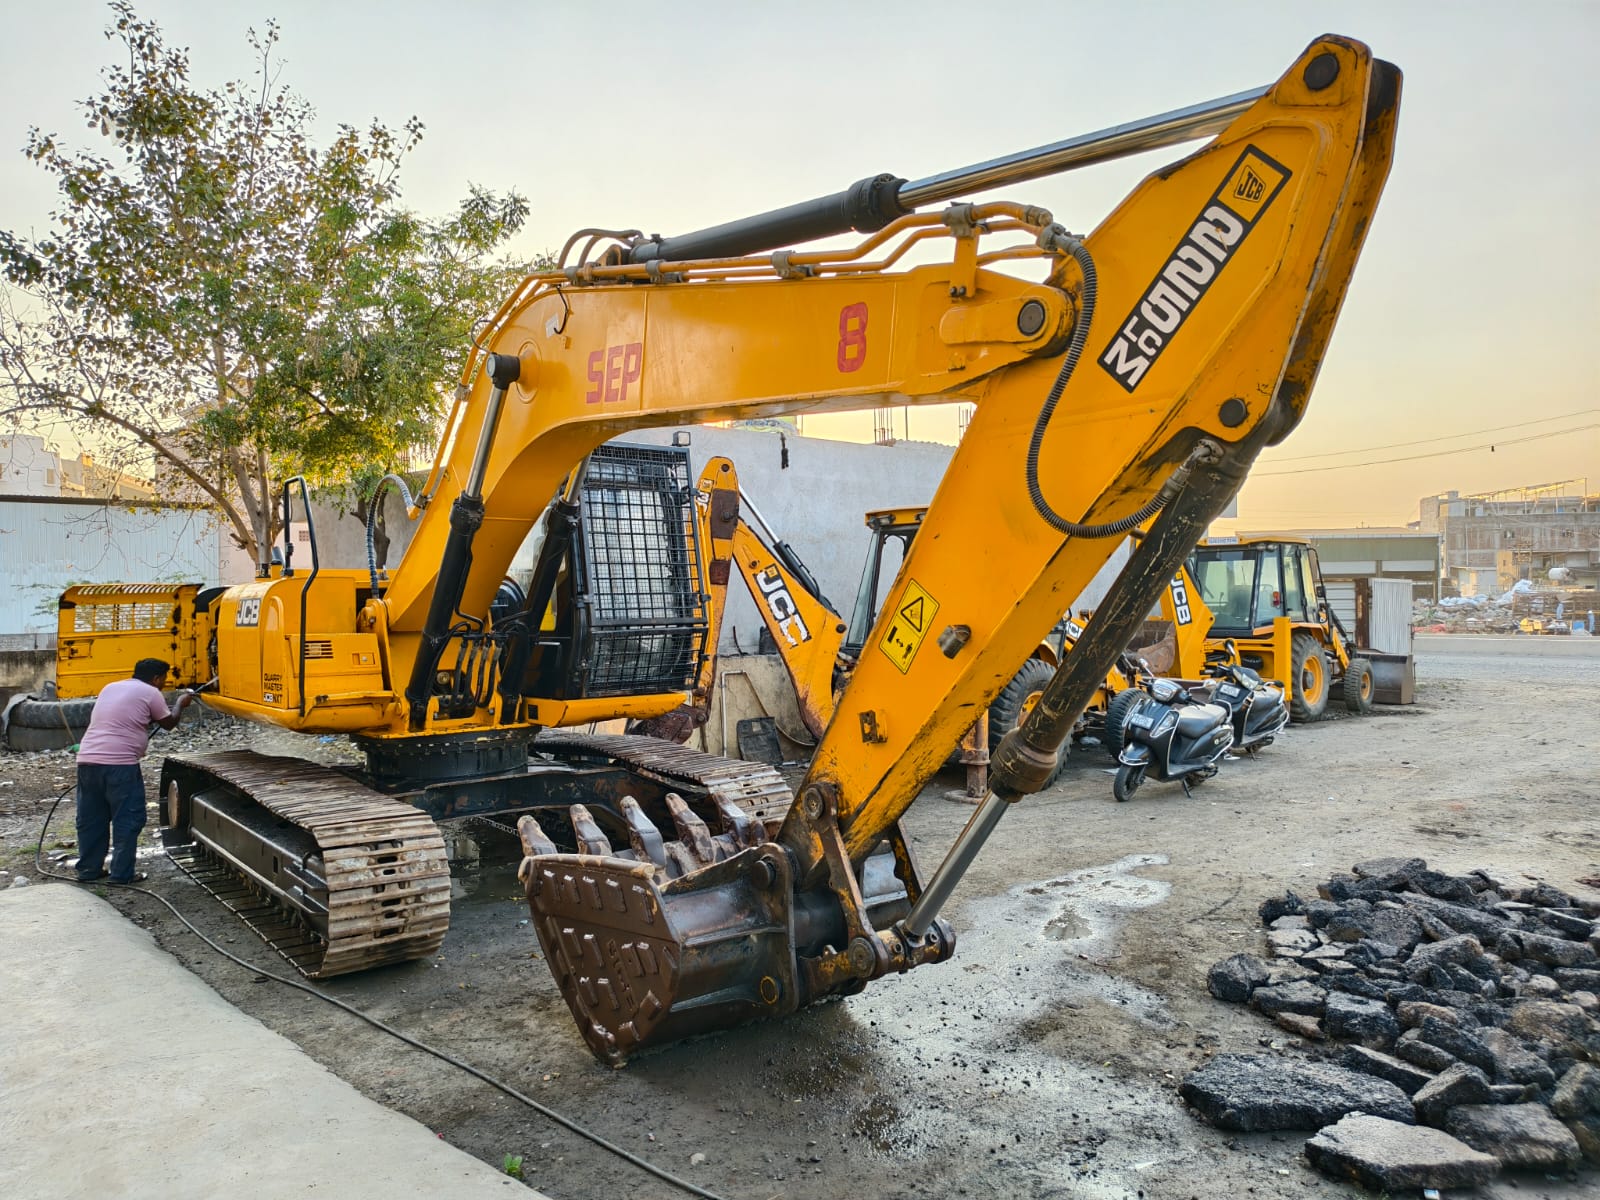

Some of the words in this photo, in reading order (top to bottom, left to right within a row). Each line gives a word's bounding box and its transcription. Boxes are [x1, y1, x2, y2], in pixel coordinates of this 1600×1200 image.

[1237, 171, 1264, 202] JCB
[837, 302, 869, 373] 8
[586, 343, 642, 404] SEP
[236, 599, 260, 626] JCB
[1171, 579, 1191, 624] JCB
[264, 673, 282, 682] QUARRY
[264, 682, 283, 691] MASTER
[273, 694, 283, 704] NXT
